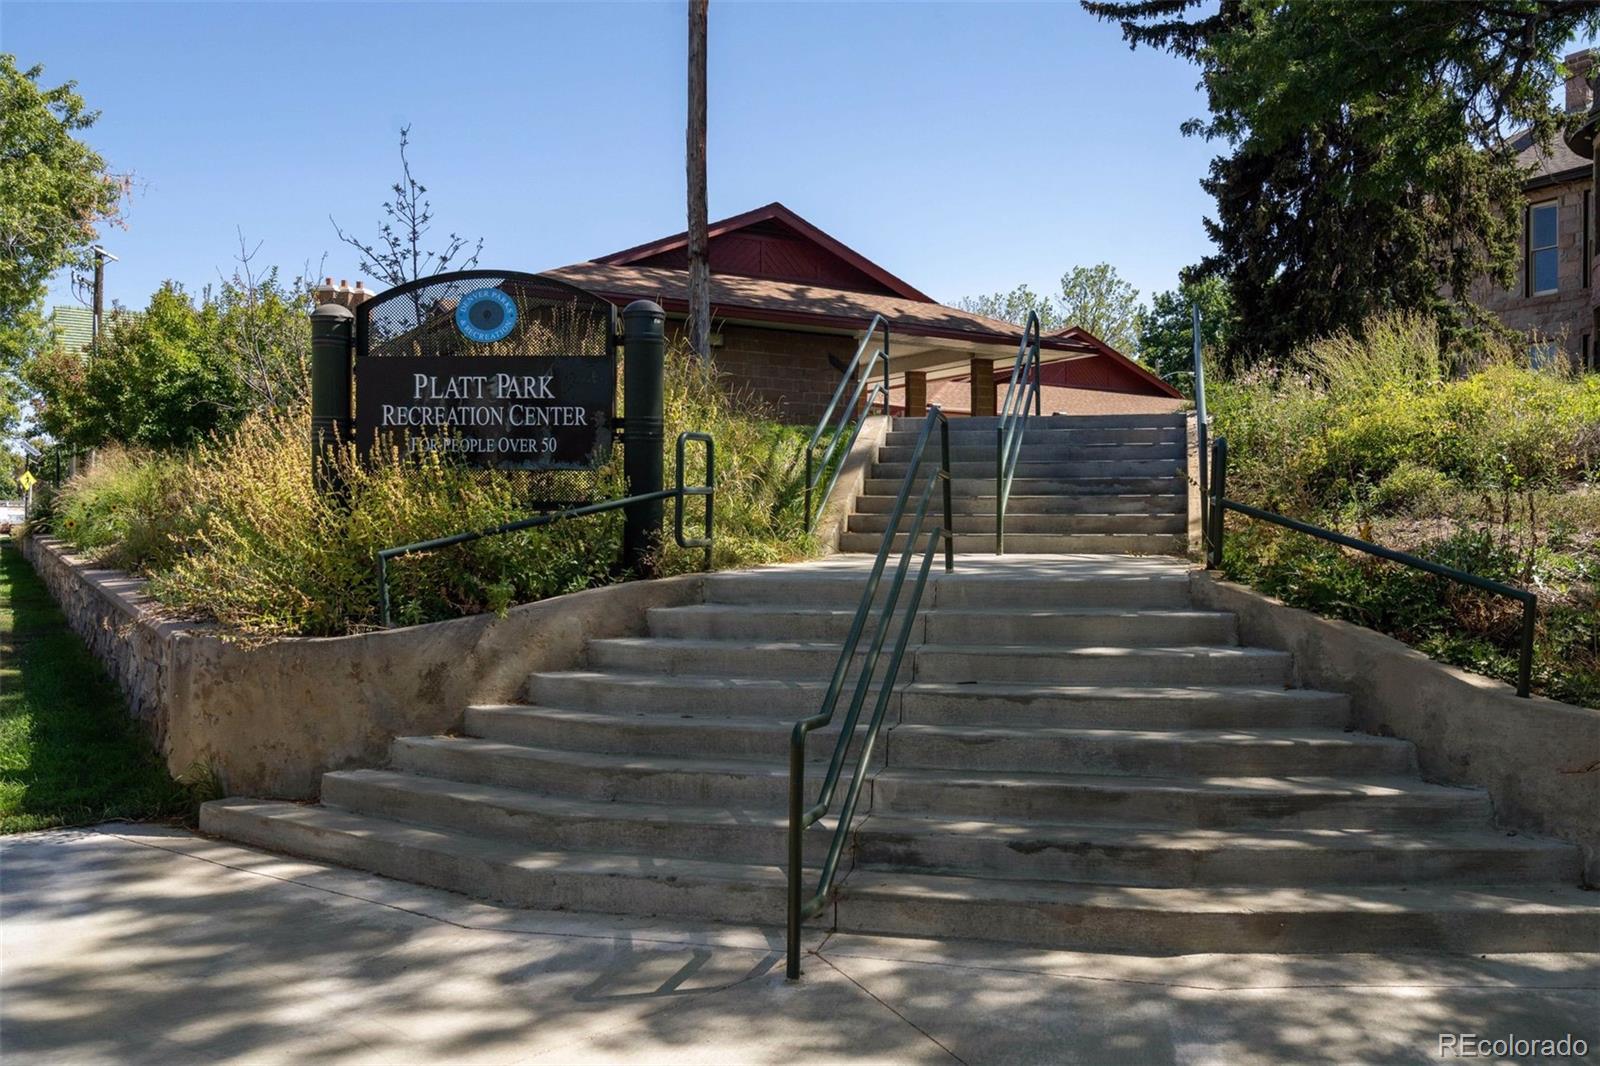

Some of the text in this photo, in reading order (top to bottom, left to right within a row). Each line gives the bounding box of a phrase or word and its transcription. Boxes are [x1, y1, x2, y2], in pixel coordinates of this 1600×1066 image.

[413, 373, 555, 400] PLATT PARK
[381, 404, 588, 426] RECREATION CENTER
[443, 437, 495, 453] PEOPLE
[498, 437, 538, 453] OVER
[541, 436, 557, 453] 50
